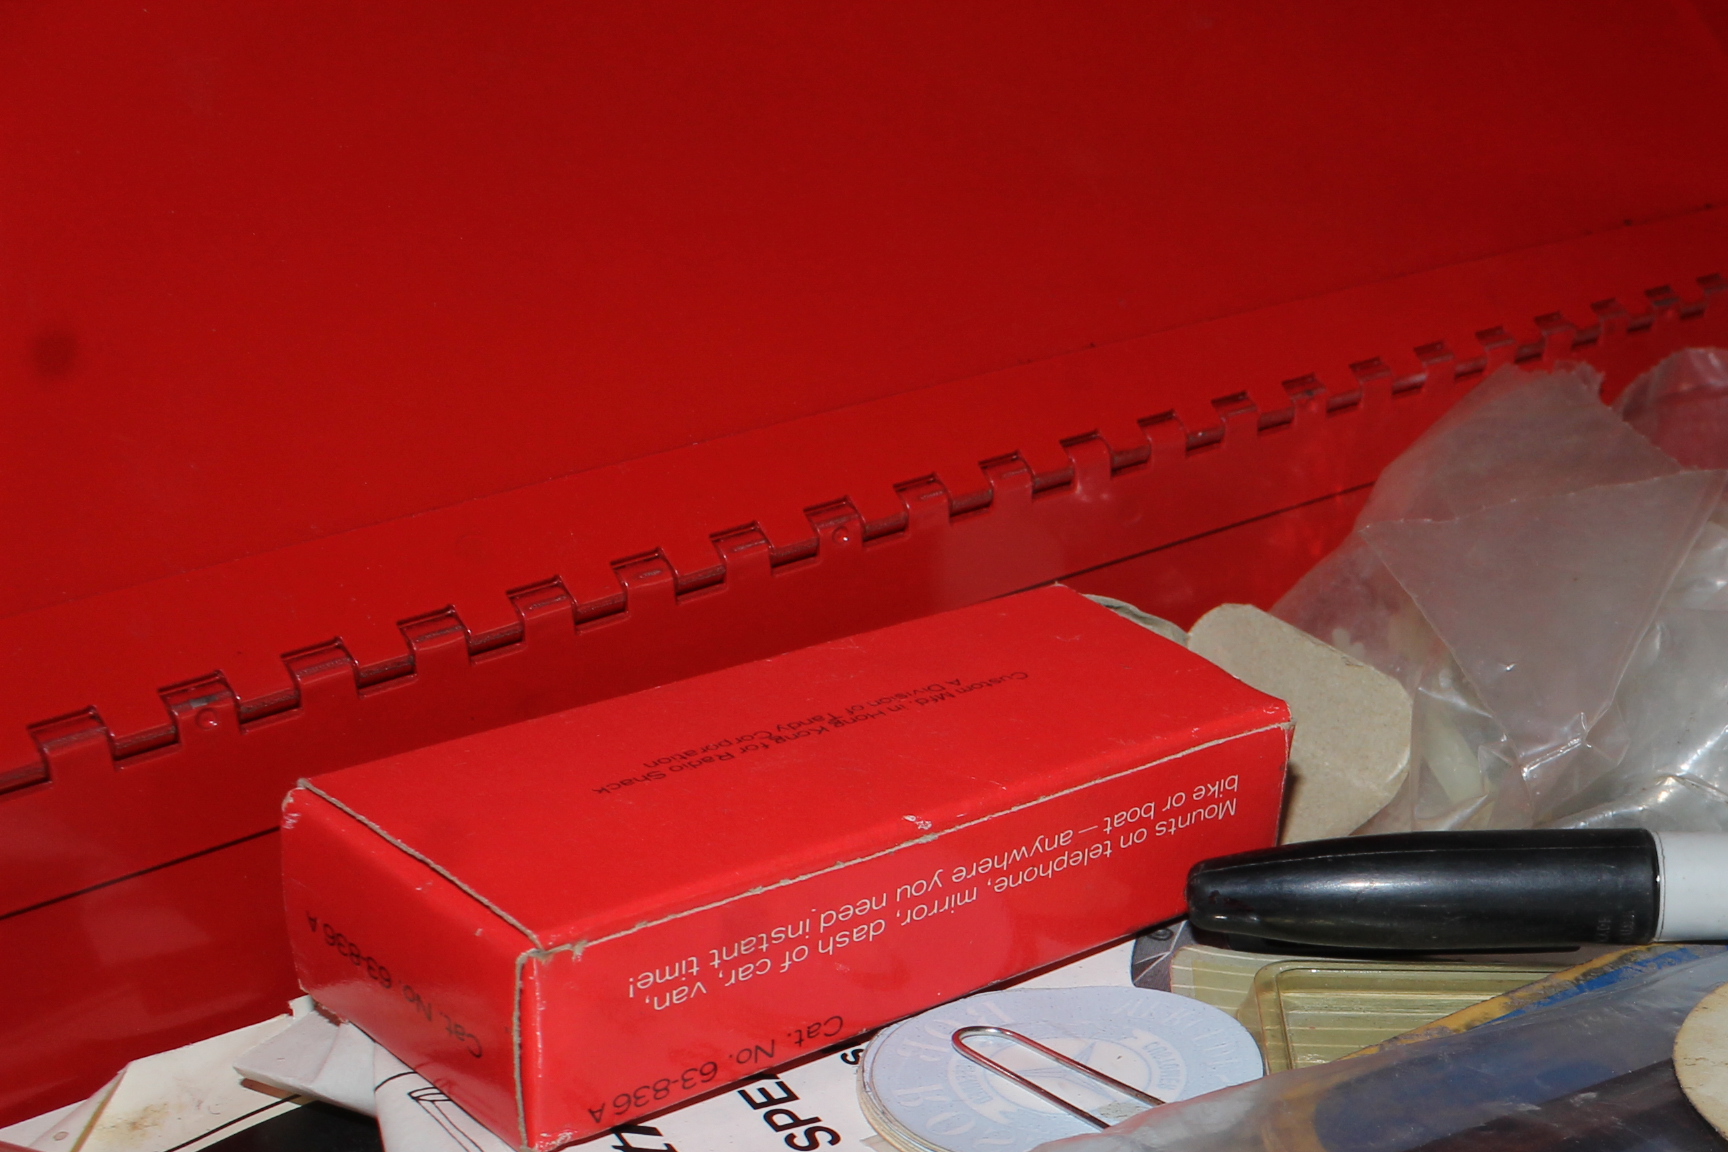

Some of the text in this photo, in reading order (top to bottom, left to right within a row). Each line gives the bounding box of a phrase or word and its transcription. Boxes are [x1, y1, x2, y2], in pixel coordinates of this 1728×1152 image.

[957, 671, 1028, 694] Custom
[643, 730, 773, 769] Corporation
[668, 751, 736, 773] Radio
[593, 770, 667, 794] Shack
[628, 774, 1240, 998] bike or boat anywhere you need instant time!
[644, 797, 1237, 1011] Mounts on telephone, mirror, dash of car, van,
[440, 1011, 483, 1059] Cat.
[787, 1014, 844, 1047] Cat.
[729, 1038, 776, 1064] No.
